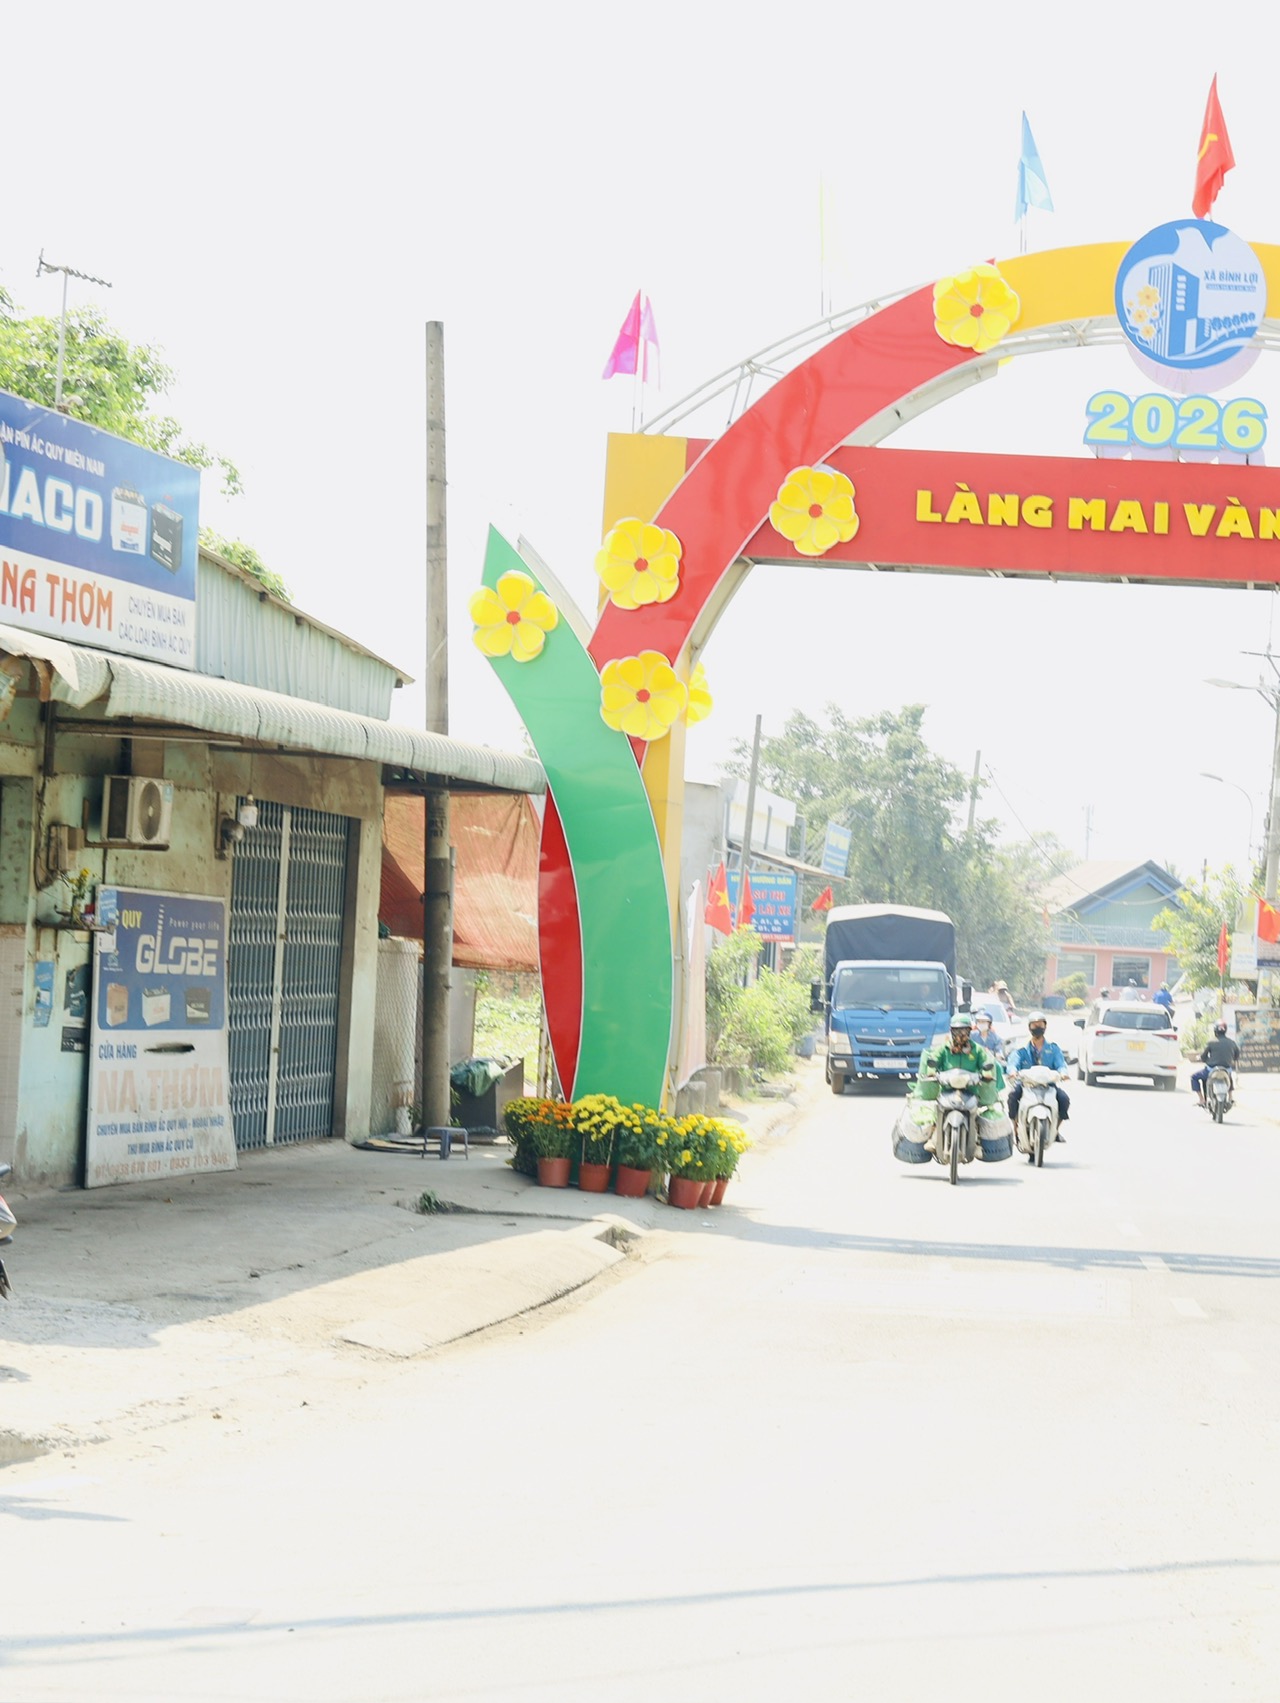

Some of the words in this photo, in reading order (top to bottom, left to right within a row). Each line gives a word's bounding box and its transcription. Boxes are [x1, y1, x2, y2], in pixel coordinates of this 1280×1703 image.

[1219, 269, 1241, 282] BÌNH
[1084, 391, 1267, 453] 2026
[15, 430, 30, 451] PIN
[916, 482, 1053, 529] LÀNG
[1067, 497, 1170, 534] MAI
[1, 560, 37, 614] NA
[46, 573, 113, 632] THƠM
[121, 909, 142, 929] QUY
[169, 917, 189, 929] Power
[191, 920, 206, 931] your
[136, 918, 219, 976] GLOBE
[116, 1043, 137, 1060] HÀNG
[97, 1070, 137, 1114] NA
[147, 1064, 224, 1111] THƠM
